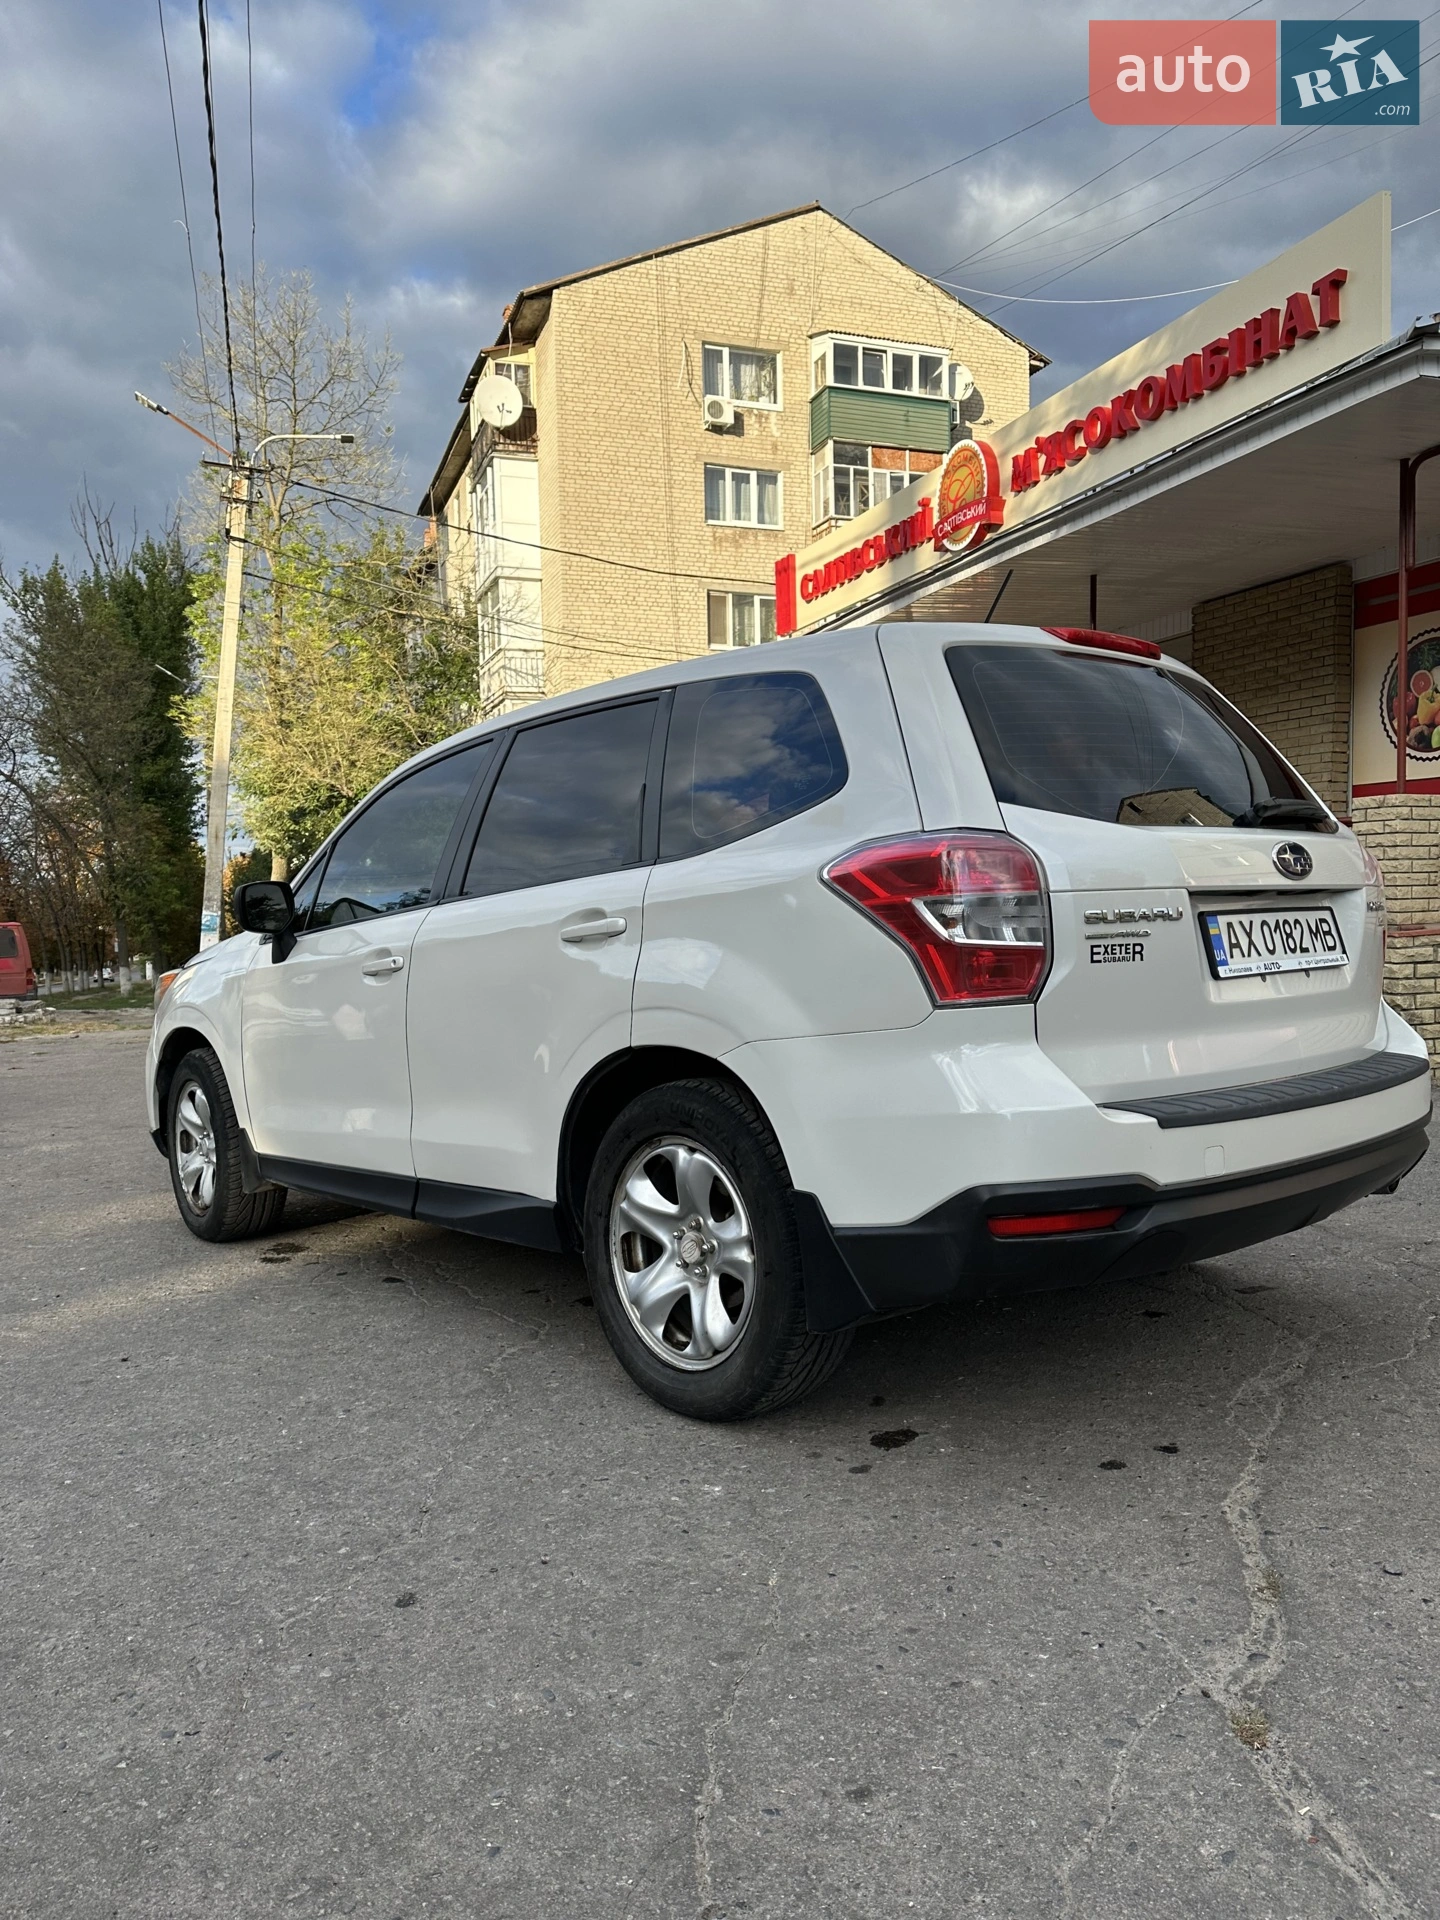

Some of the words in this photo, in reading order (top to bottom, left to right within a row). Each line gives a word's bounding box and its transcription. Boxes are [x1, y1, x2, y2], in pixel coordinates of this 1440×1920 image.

[800, 497, 934, 603] САЛТІВСЬКИЙ
[1010, 268, 1348, 493] М'ЯСОКОМБІНАТ
[937, 499, 987, 537] САЛТІВСЬКИЙ
[1084, 906, 1184, 925] SUBARU
[1226, 920, 1262, 959] AX
[1260, 918, 1310, 956] 0182
[1305, 917, 1337, 953] MB
[1090, 943, 1144, 963] EXETER
[1214, 949, 1226, 961] UA
